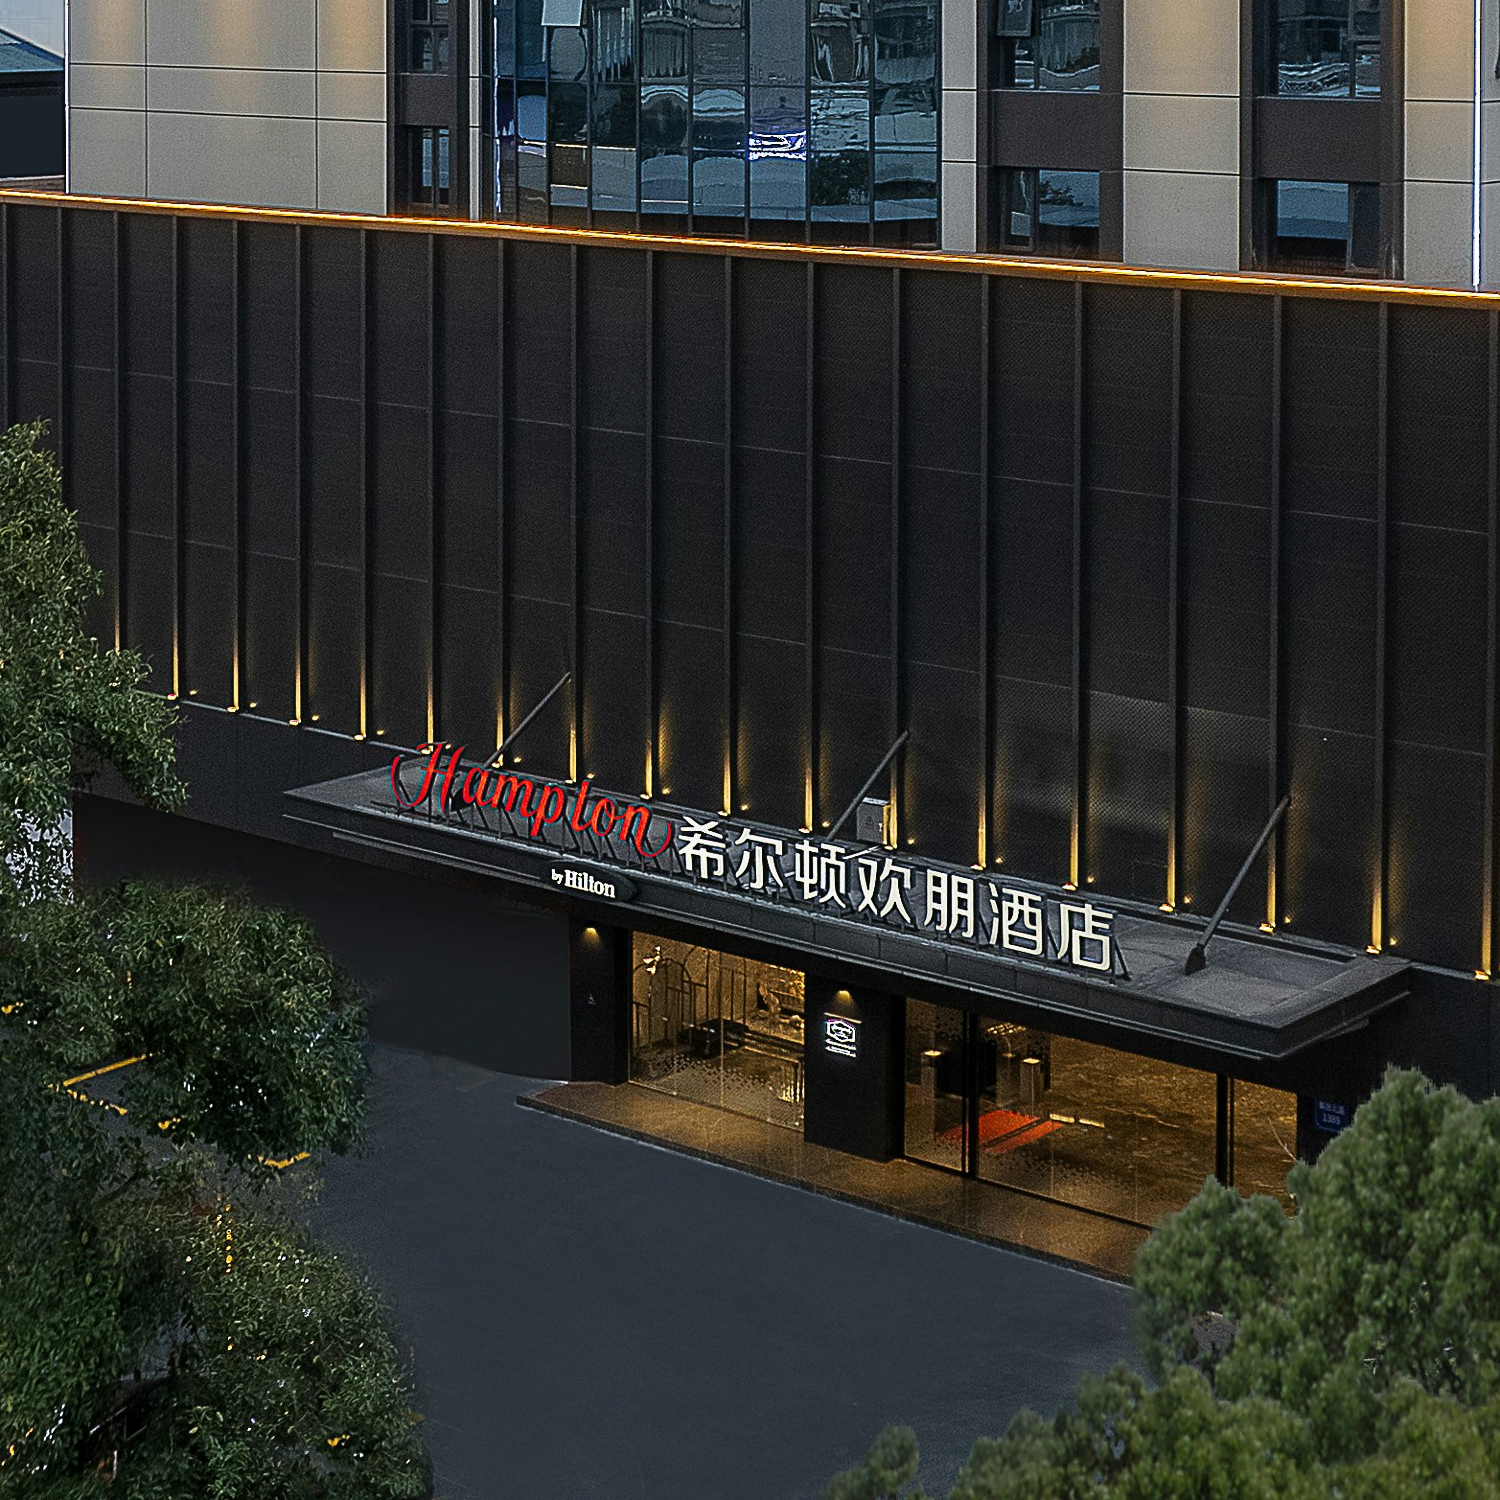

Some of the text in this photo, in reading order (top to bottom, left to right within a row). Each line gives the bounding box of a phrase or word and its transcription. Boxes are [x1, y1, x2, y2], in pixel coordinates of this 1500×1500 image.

[390, 742, 672, 858] Hampton
[551, 868, 616, 899] by Hilton
[678, 815, 1114, 972] 希尔顿欢朋酒店
